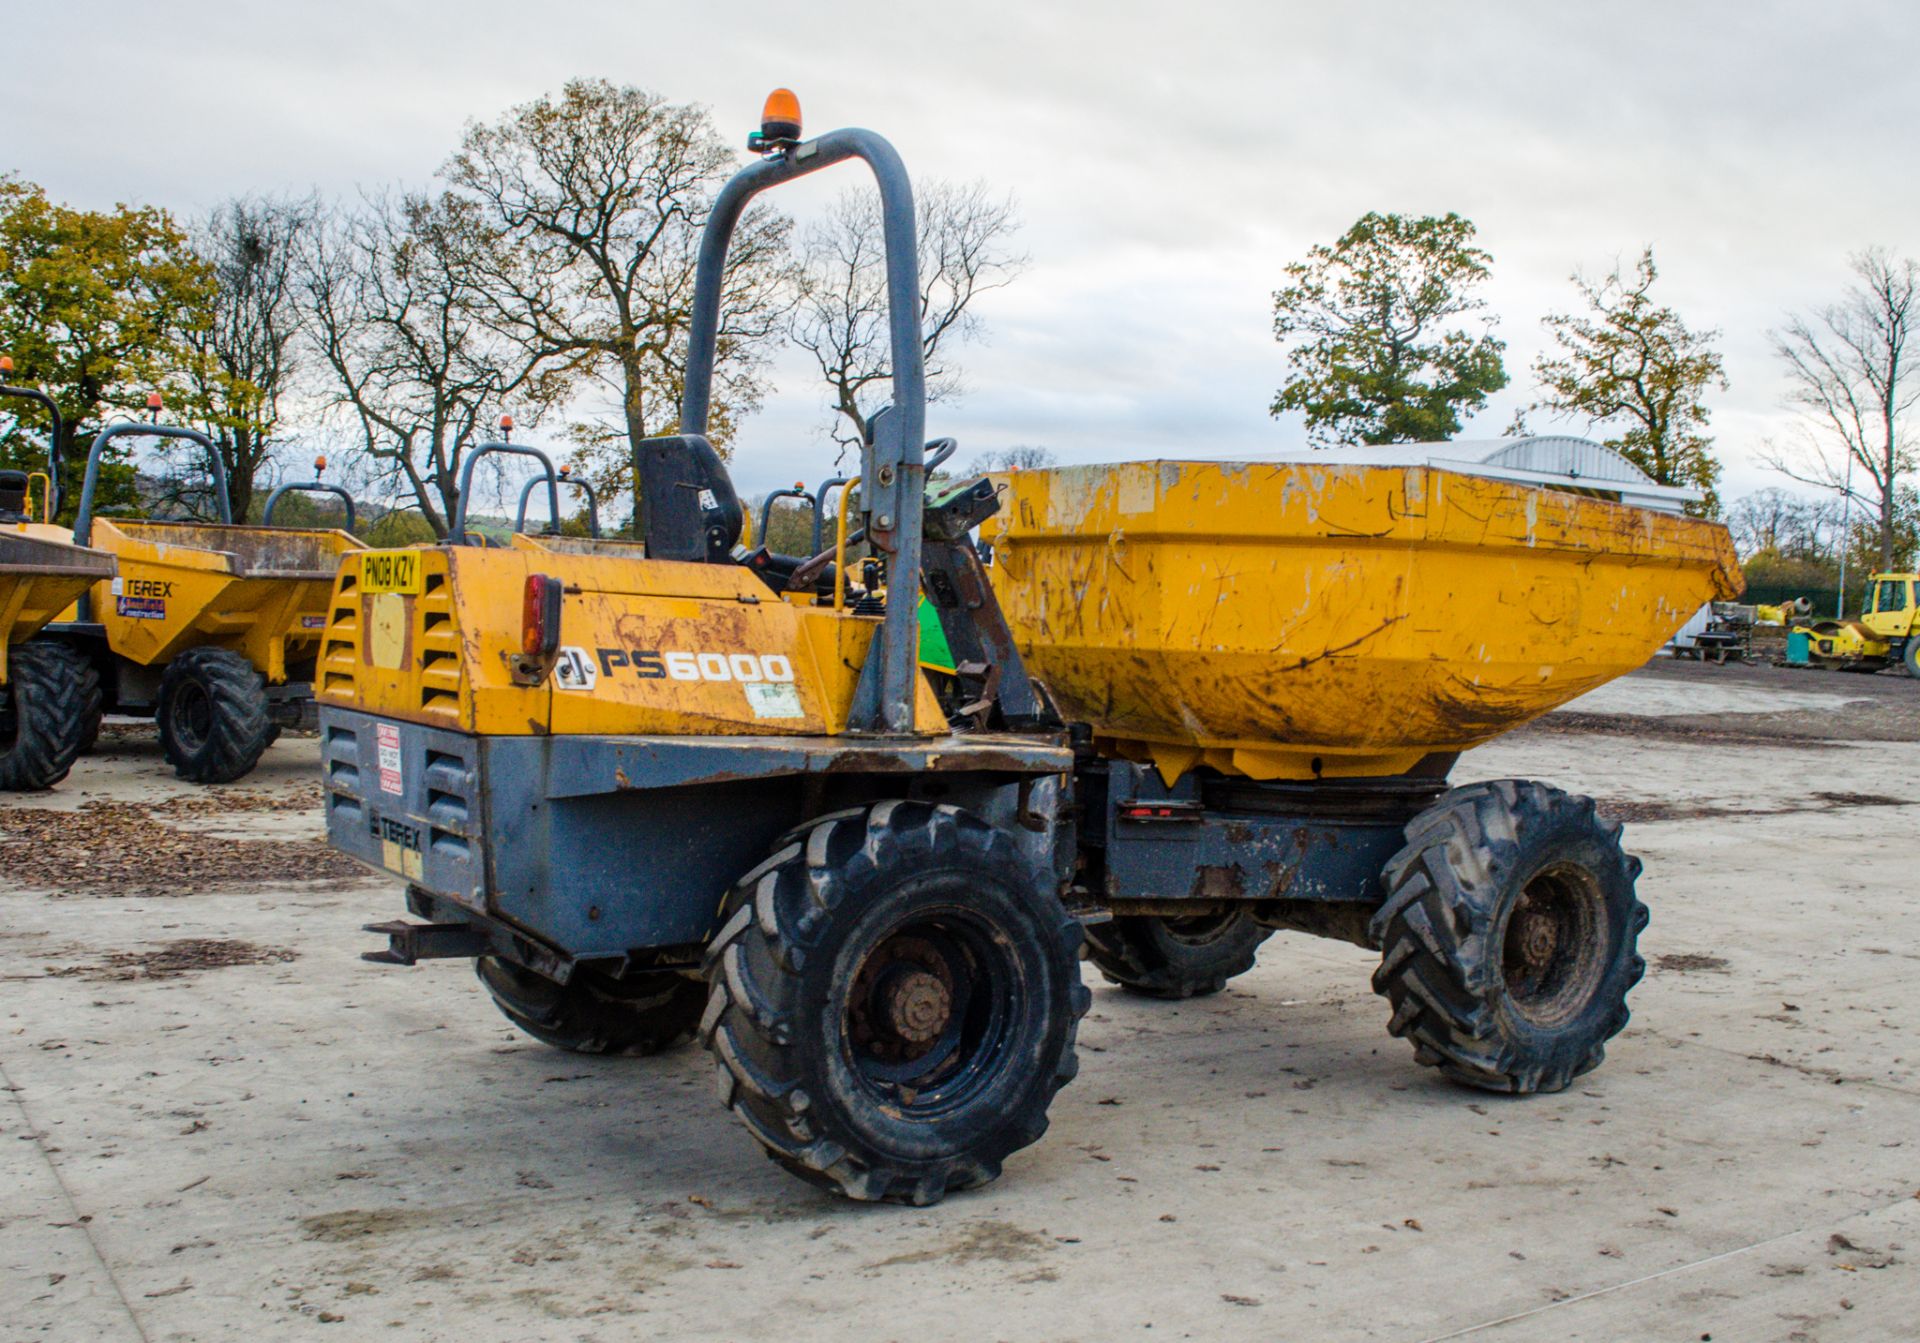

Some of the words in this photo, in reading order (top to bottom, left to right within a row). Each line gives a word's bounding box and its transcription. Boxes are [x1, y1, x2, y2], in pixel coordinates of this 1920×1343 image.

[365, 557, 391, 586] PN08
[394, 556, 415, 586] KZY
[128, 580, 172, 597] TEREX
[596, 647, 794, 682] PS6000
[380, 817, 420, 852] TEREX
